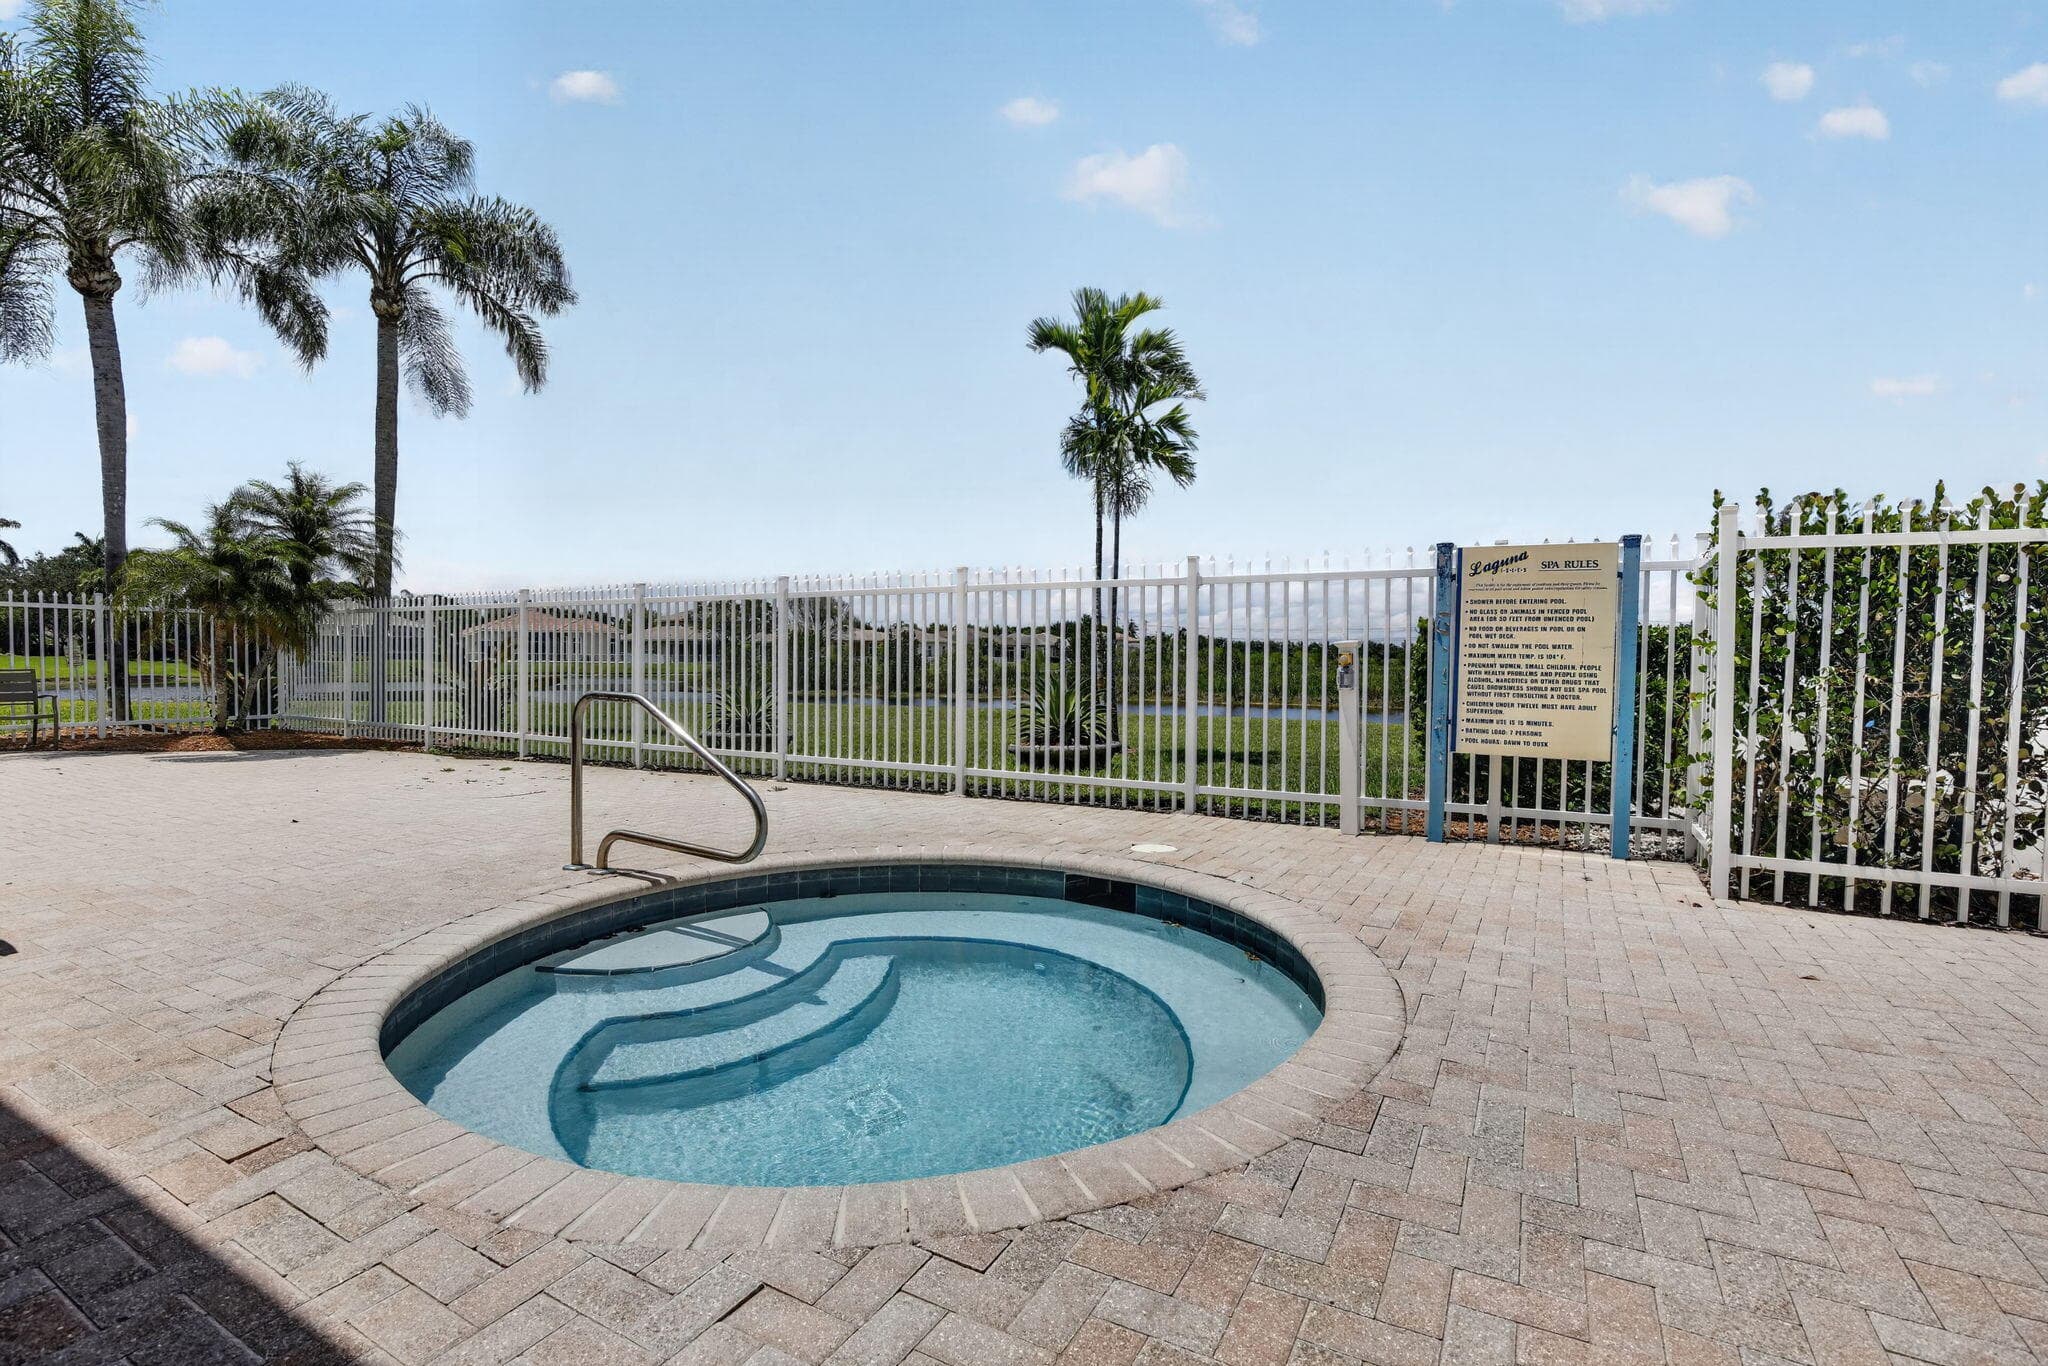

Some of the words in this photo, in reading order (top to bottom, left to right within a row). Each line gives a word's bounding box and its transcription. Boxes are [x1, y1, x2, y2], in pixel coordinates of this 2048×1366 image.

[1468, 551, 1529, 577] Laguna
[1541, 560, 1559, 569] SPA
[1564, 560, 1599, 568] RULES
